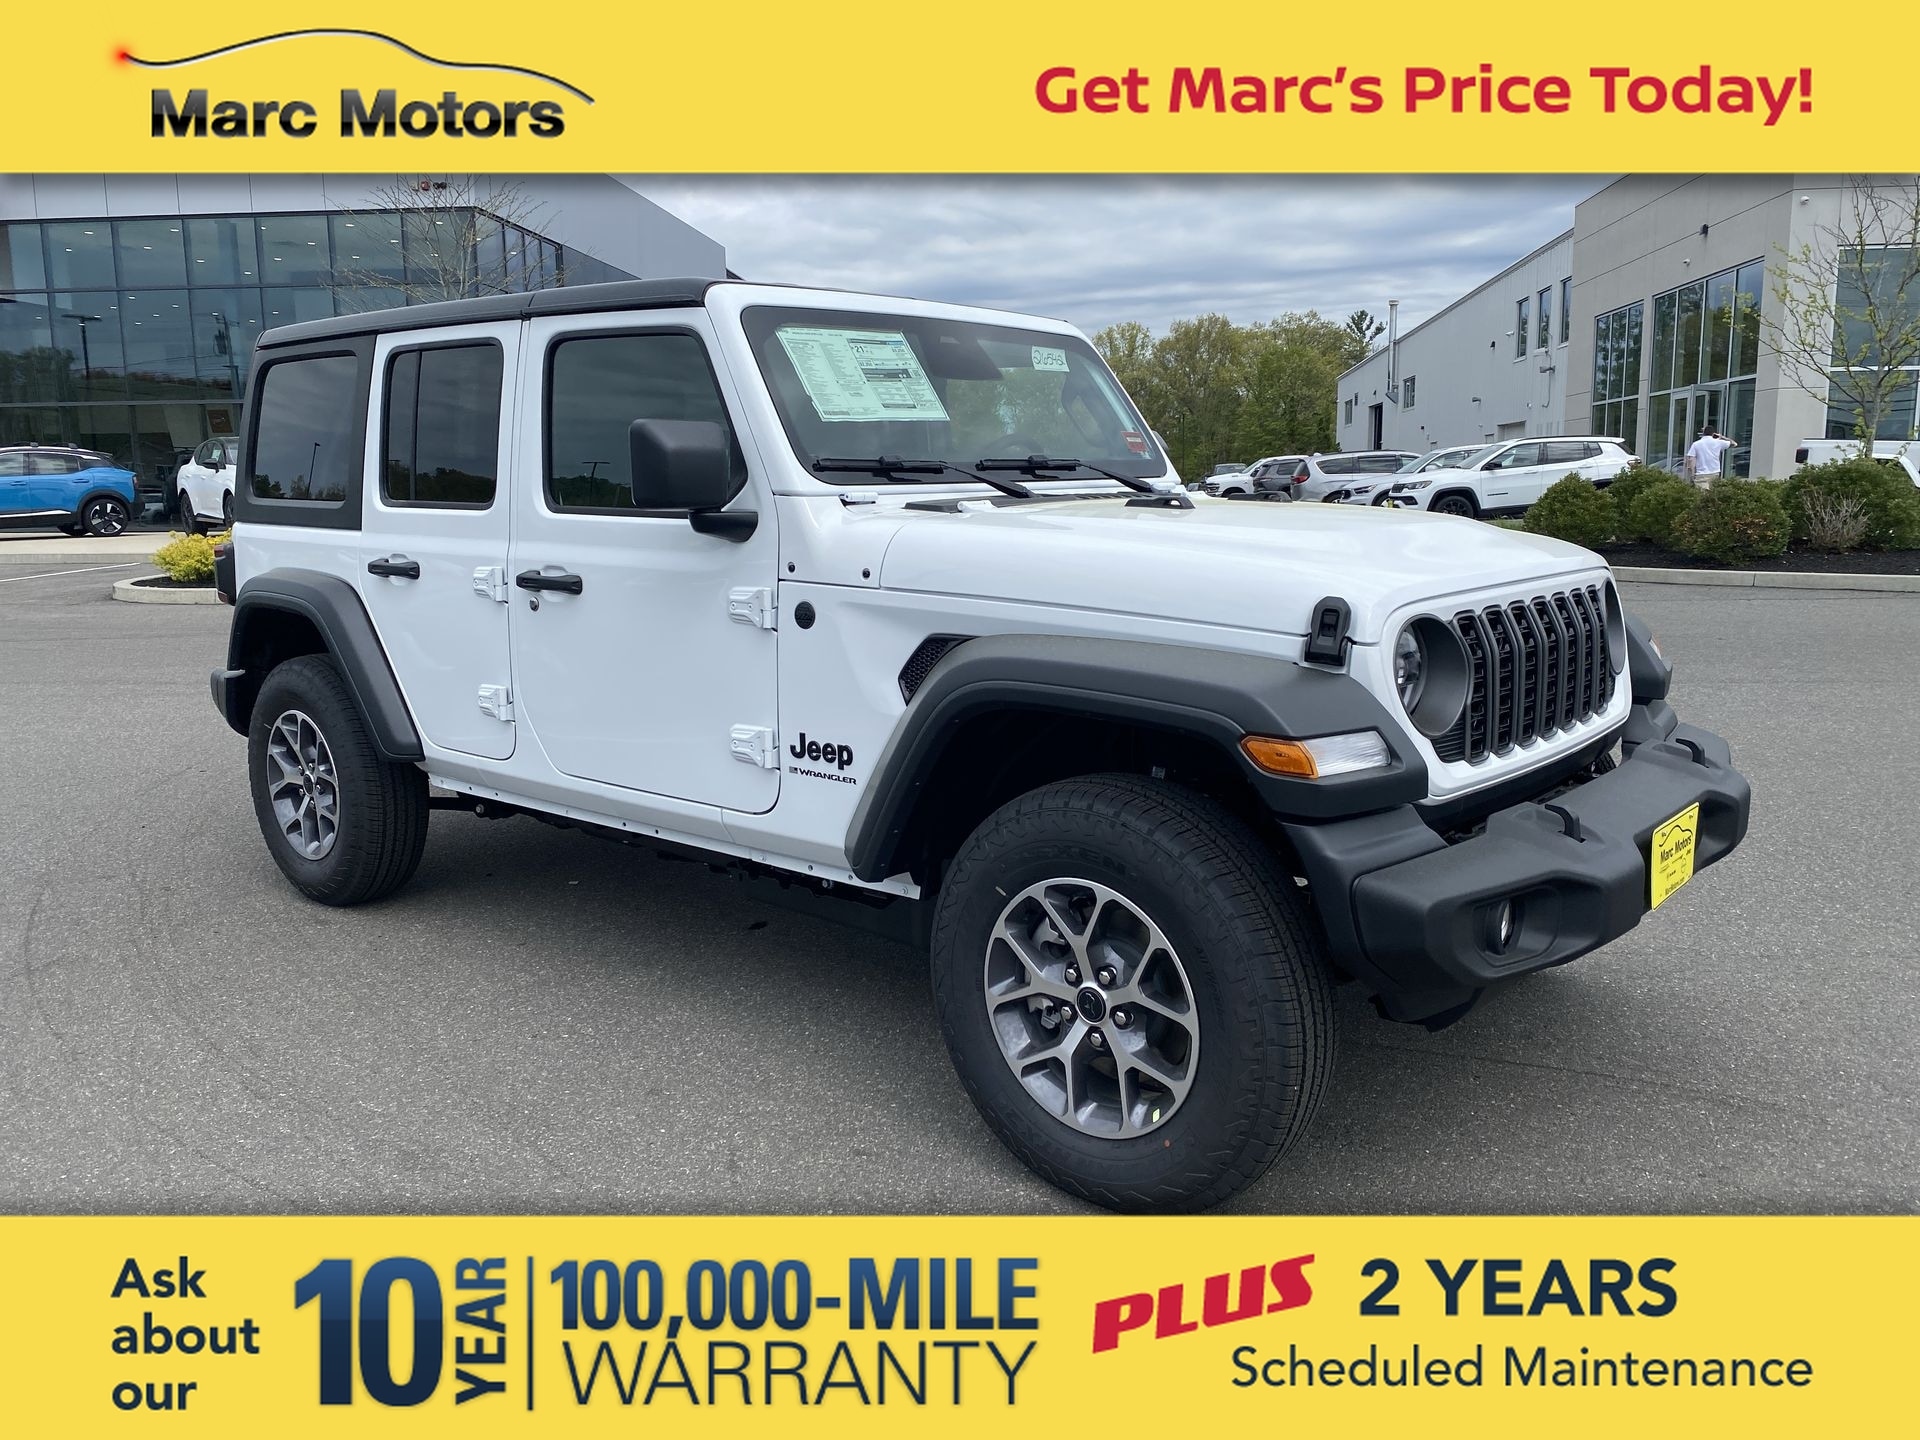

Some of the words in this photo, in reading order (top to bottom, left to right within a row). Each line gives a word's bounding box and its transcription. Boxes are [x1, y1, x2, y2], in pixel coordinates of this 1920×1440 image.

[789, 732, 854, 771] Jeep
[799, 767, 857, 785] WRANGLER
[1660, 847, 1674, 864] Marc
[1674, 834, 1692, 855] Motors
